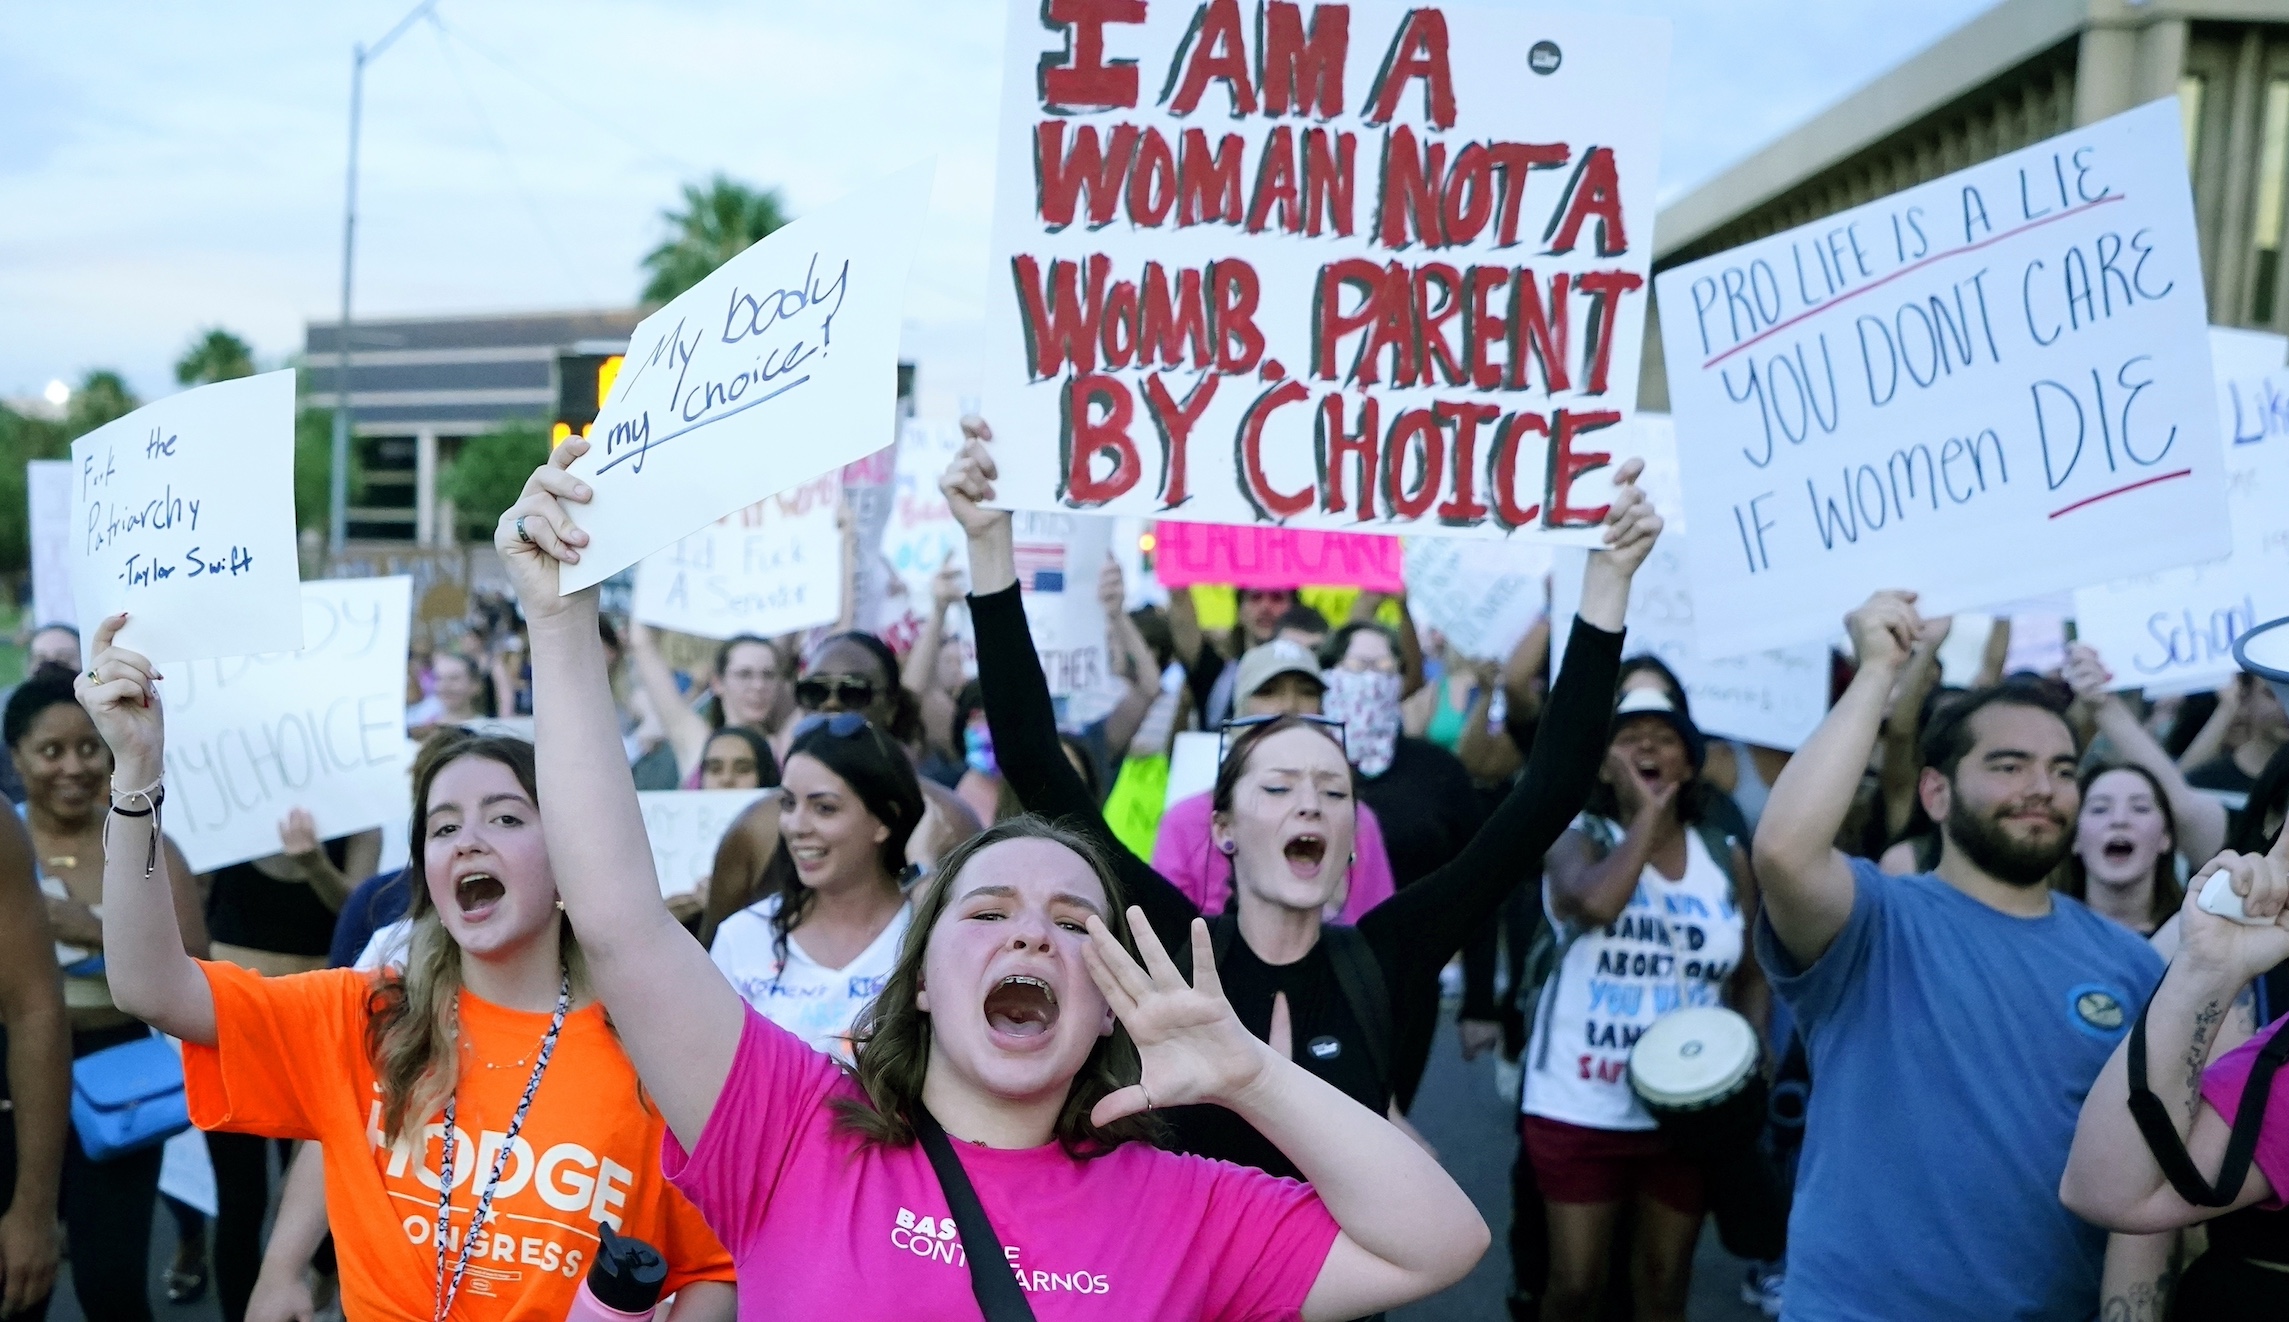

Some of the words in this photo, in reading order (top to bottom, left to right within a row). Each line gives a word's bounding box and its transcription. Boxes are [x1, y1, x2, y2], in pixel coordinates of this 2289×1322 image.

[1037, 0, 1148, 115] I
[1157, 0, 1350, 123] AM
[1360, 8, 1457, 132] A
[1033, 119, 1358, 238] WOMAN
[1368, 124, 1572, 252] NOT
[1542, 145, 1628, 257] A
[1690, 258, 1781, 356] PRO
[1792, 221, 1873, 306] LIFE
[1892, 205, 1928, 262] IS
[1962, 185, 1992, 243] A
[2018, 145, 2110, 221] LIE
[620, 316, 704, 412] My
[721, 252, 849, 344] body
[1308, 258, 1645, 397] PARENT
[1720, 332, 1839, 469] YOU
[1856, 267, 2001, 407] DONT
[2023, 228, 2174, 347] CARE
[146, 426, 178, 459] the
[606, 411, 650, 474] my
[683, 315, 832, 442] choice!
[1055, 370, 1218, 512] BY
[1234, 378, 1622, 535] CHOICE
[86, 484, 200, 556] Patriarchy
[1734, 491, 1777, 574] IF
[2030, 355, 2177, 491] DIE
[186, 546, 253, 578] Swift
[216, 692, 398, 812] CHOICE
[1596, 948, 1728, 981] ABORTON
[1577, 1052, 1625, 1084] SAF
[402, 1215, 583, 1278] ONGRESS
[896, 1207, 957, 1240] BAS
